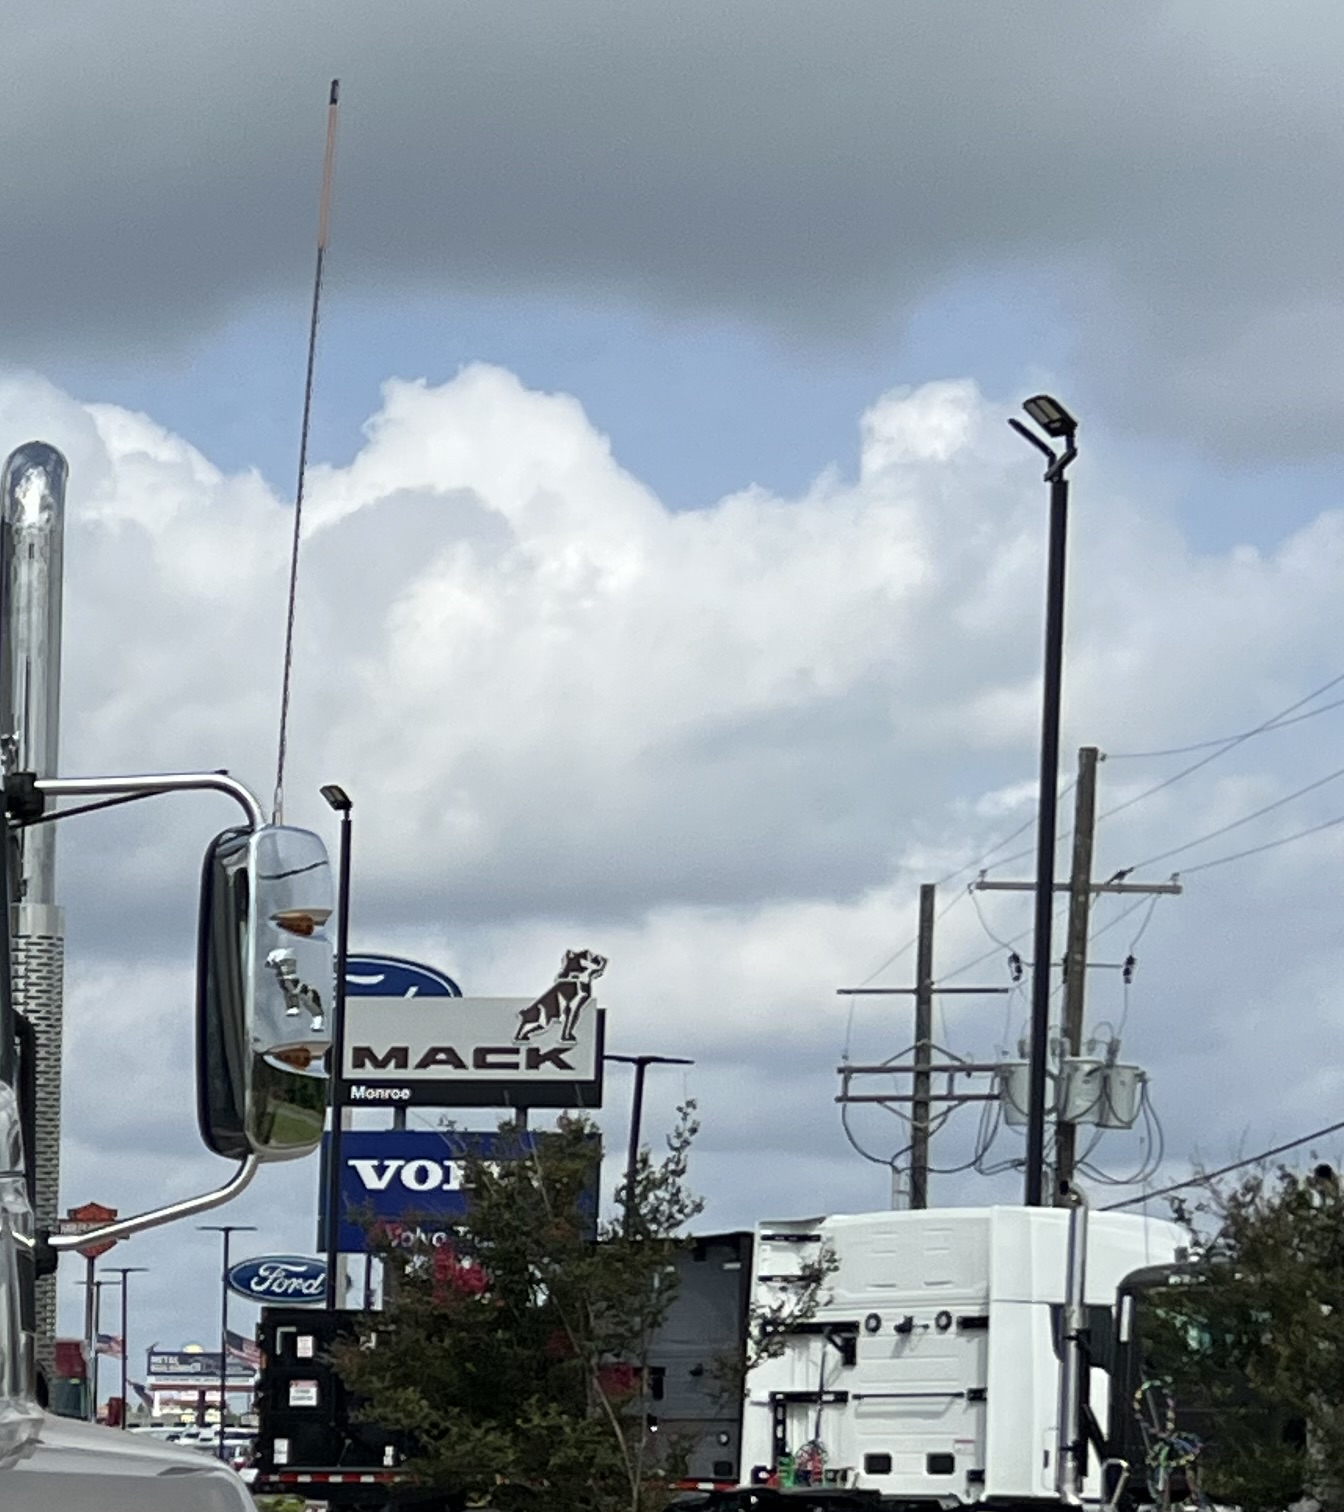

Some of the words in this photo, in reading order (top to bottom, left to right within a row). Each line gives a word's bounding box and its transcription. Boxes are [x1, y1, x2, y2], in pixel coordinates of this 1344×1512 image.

[351, 1046, 576, 1070] MACK
[350, 1085, 411, 1100] Monroe
[250, 1262, 327, 1295] Ford
